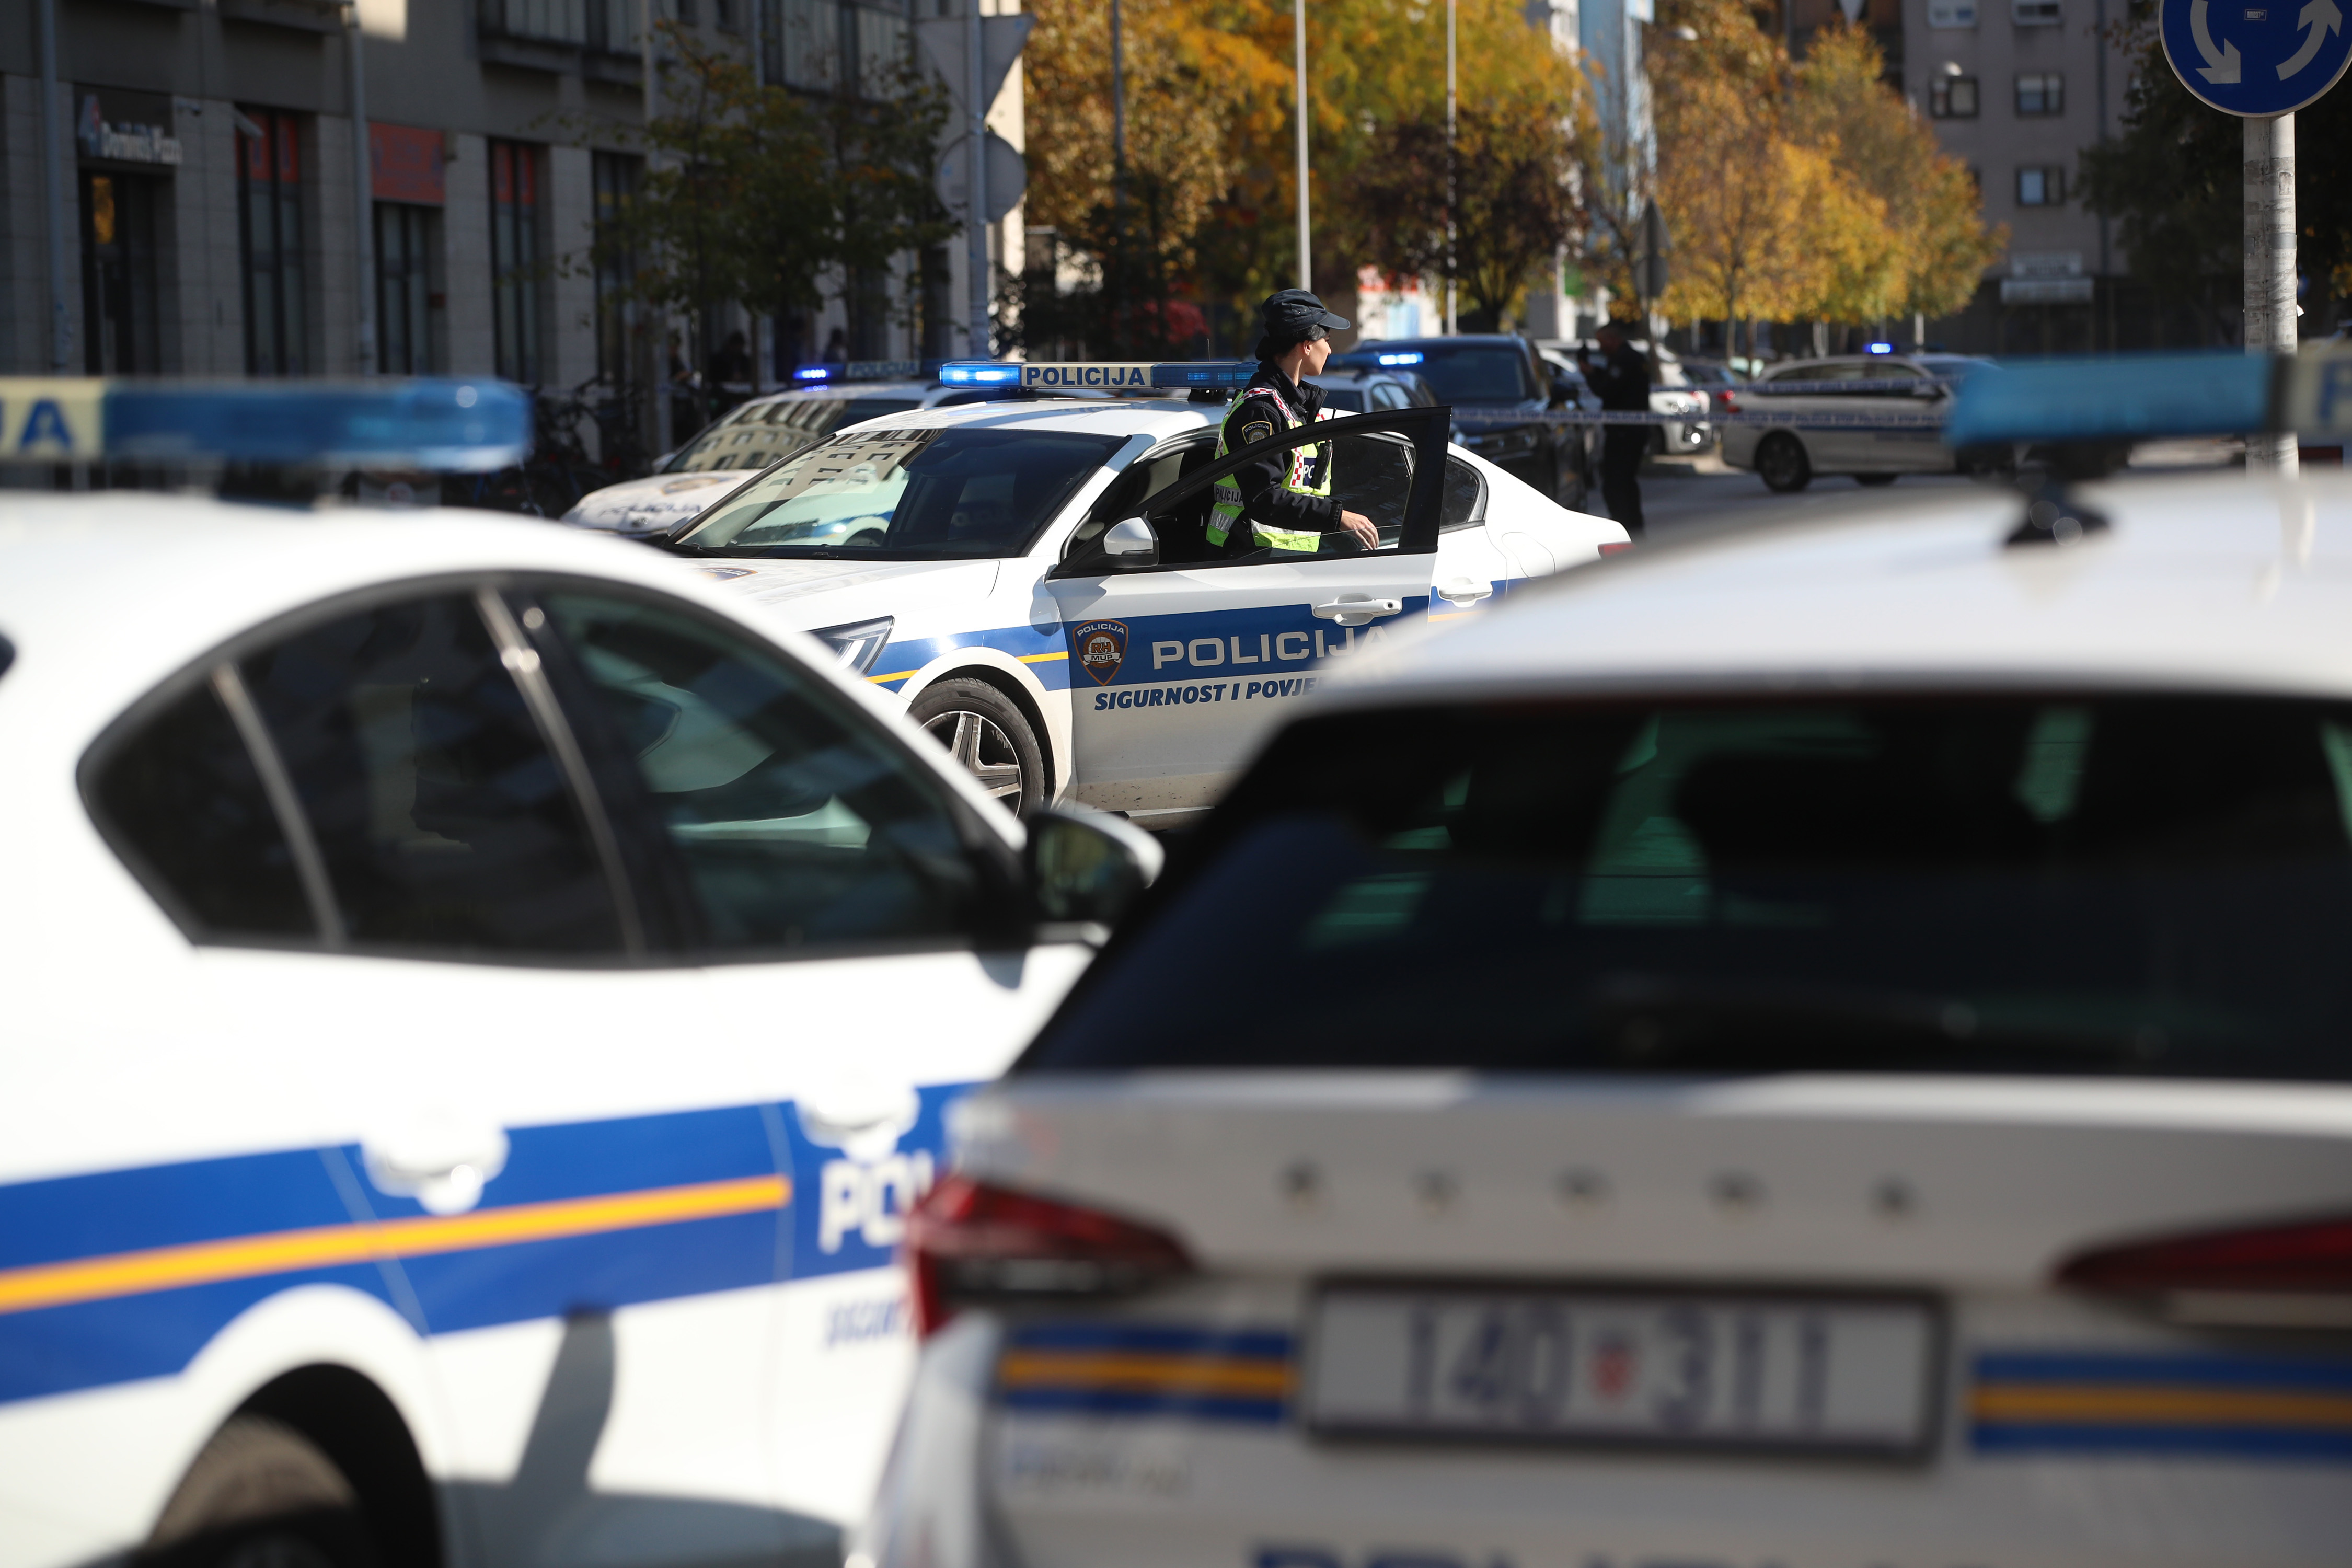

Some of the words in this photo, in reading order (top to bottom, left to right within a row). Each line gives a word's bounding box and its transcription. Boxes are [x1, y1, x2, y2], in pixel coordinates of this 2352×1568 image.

[1027, 367, 1145, 385] POLICIJA
[1244, 423, 1269, 433] POLICIJA
[1077, 623, 1124, 637] POLICIJA
[1091, 642, 1112, 653] RH
[1152, 626, 1392, 670] POLICIJA
[1094, 684, 1227, 711] SIGURNOST
[1231, 683, 1241, 700] I
[1246, 677, 1322, 699] POVJE
